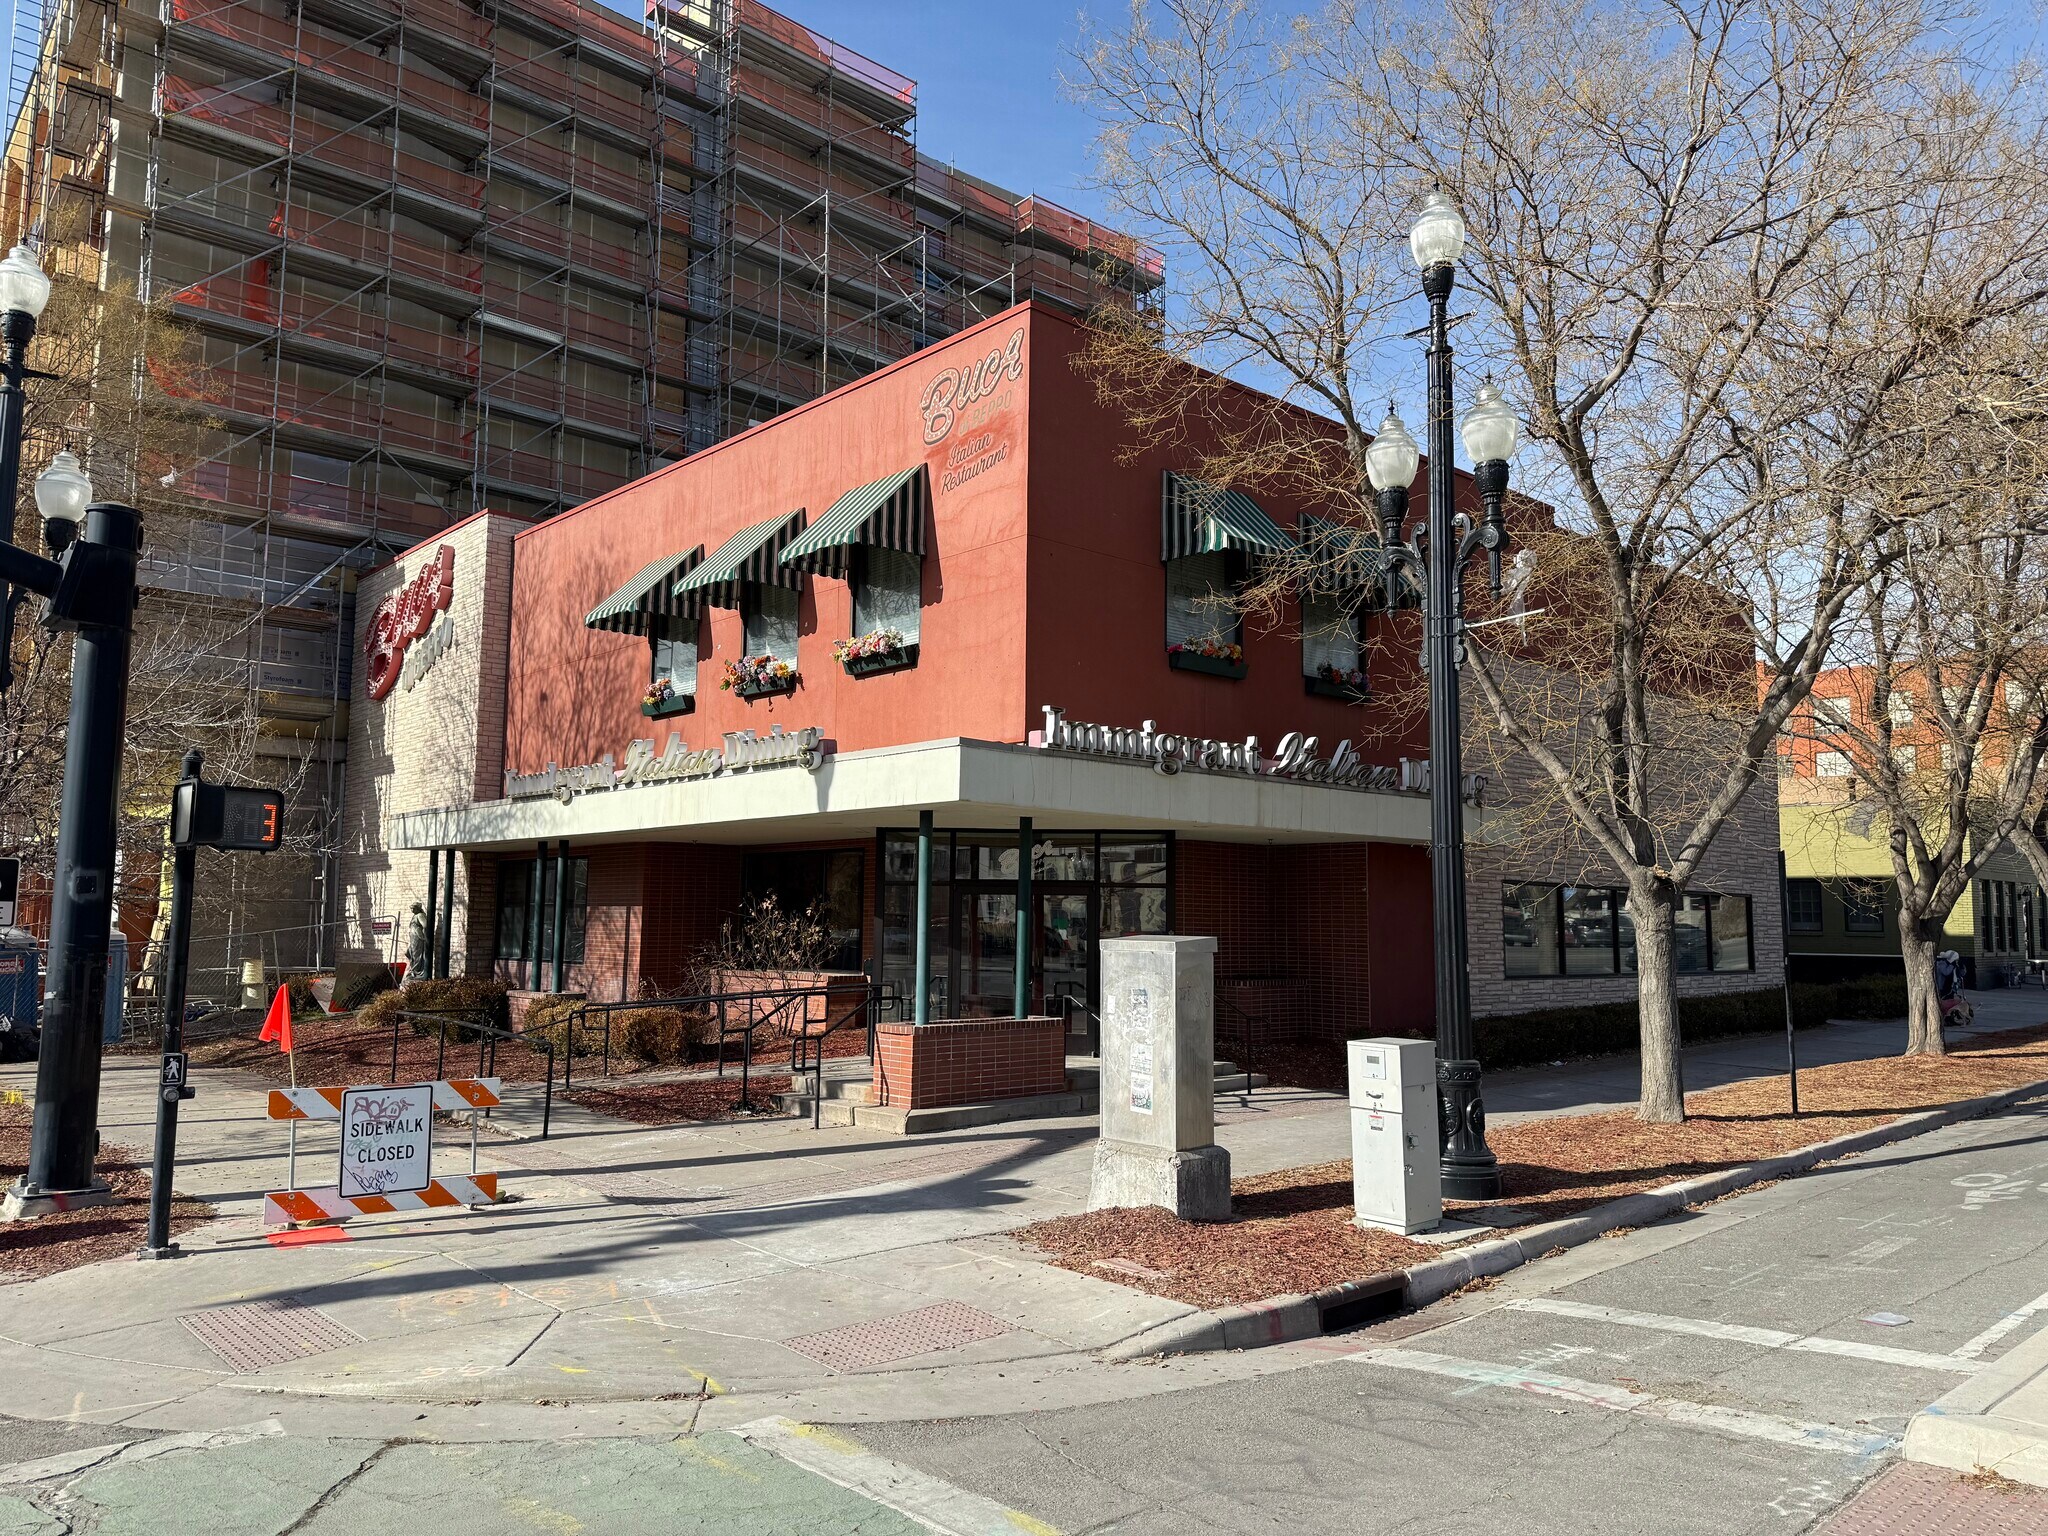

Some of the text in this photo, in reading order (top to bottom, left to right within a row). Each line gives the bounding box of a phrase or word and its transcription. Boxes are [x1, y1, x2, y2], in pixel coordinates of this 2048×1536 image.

[972, 390, 1012, 428] BEPPO
[949, 433, 991, 467] Italian
[941, 443, 1008, 496] Restaurant
[263, 674, 294, 684] Styrofoam
[504, 723, 825, 805] Immigrant Italian Dining
[1041, 704, 1262, 776] Immigrant
[1266, 731, 1398, 790] Italian
[261, 804, 277, 842] 3
[351, 1117, 424, 1138] SIDEWALK
[357, 1144, 415, 1164] CLOSED
